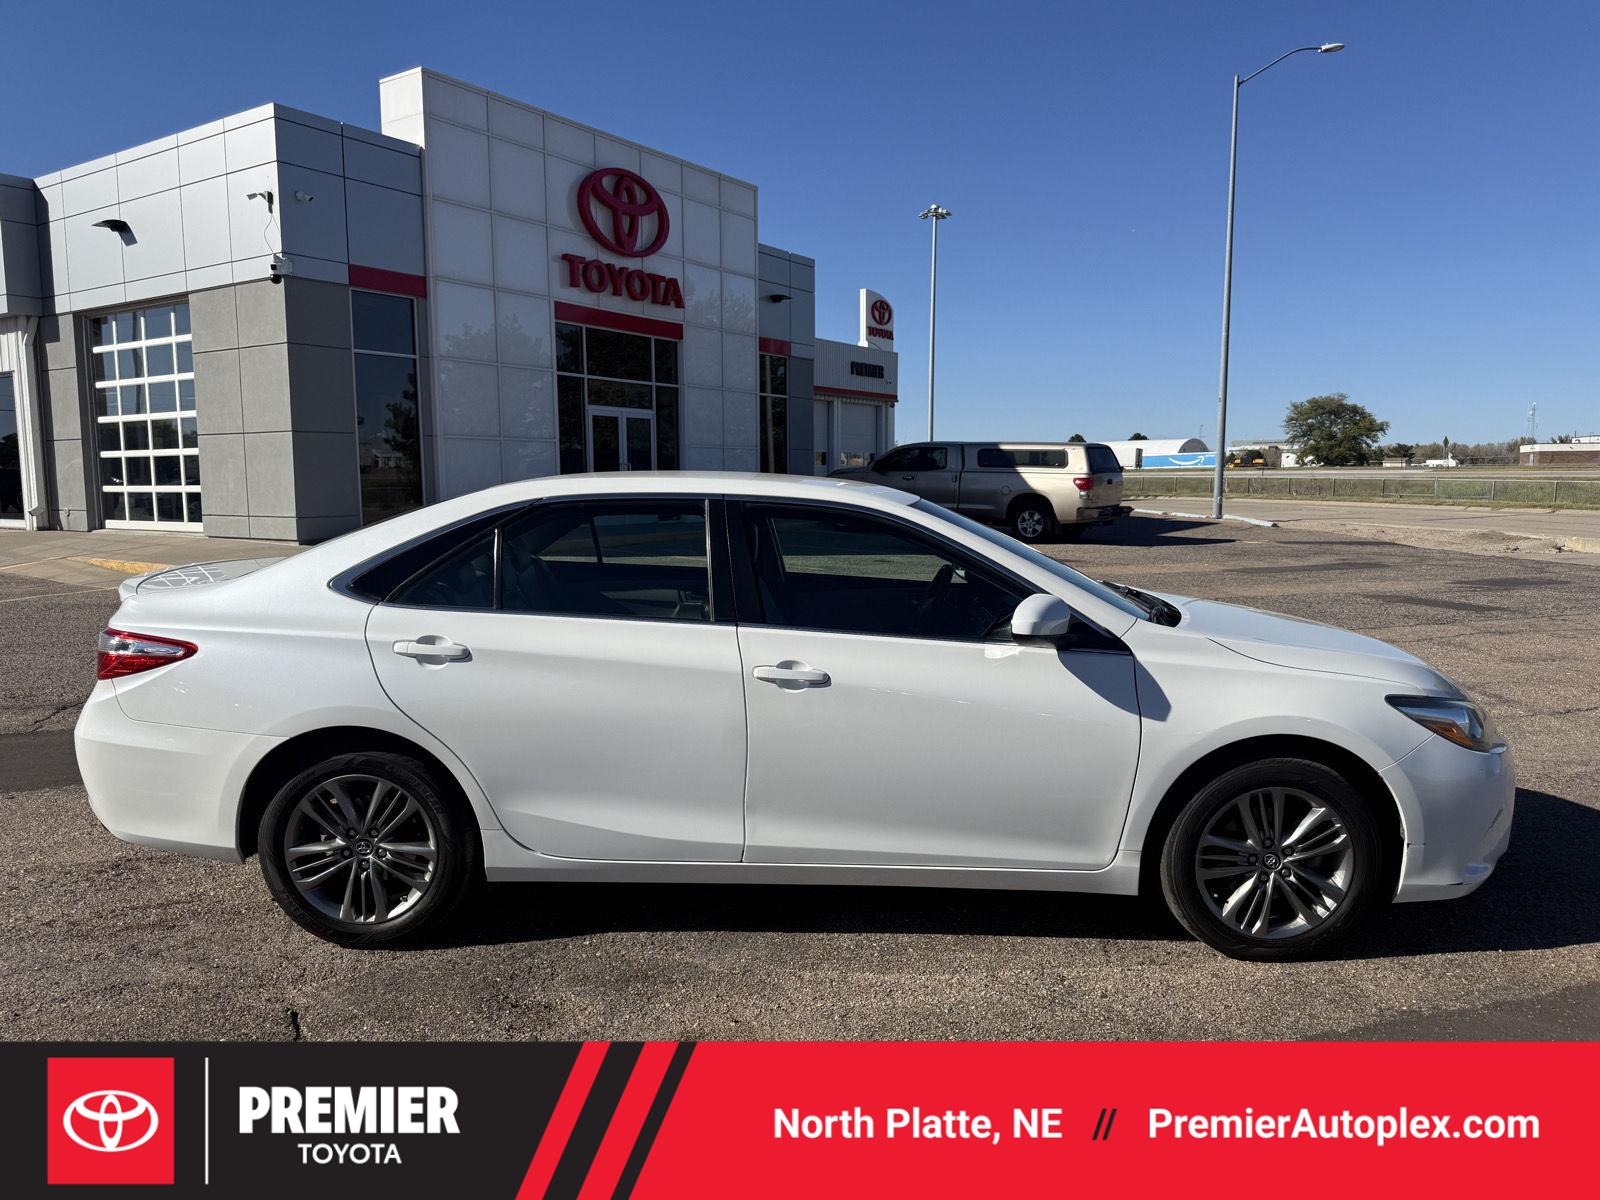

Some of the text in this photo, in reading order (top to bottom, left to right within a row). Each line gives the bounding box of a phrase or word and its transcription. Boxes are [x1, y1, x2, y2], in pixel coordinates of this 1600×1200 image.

[561, 253, 685, 309] TOYOTA
[867, 326, 894, 341] TOYOTA
[850, 361, 885, 379] PREMIER
